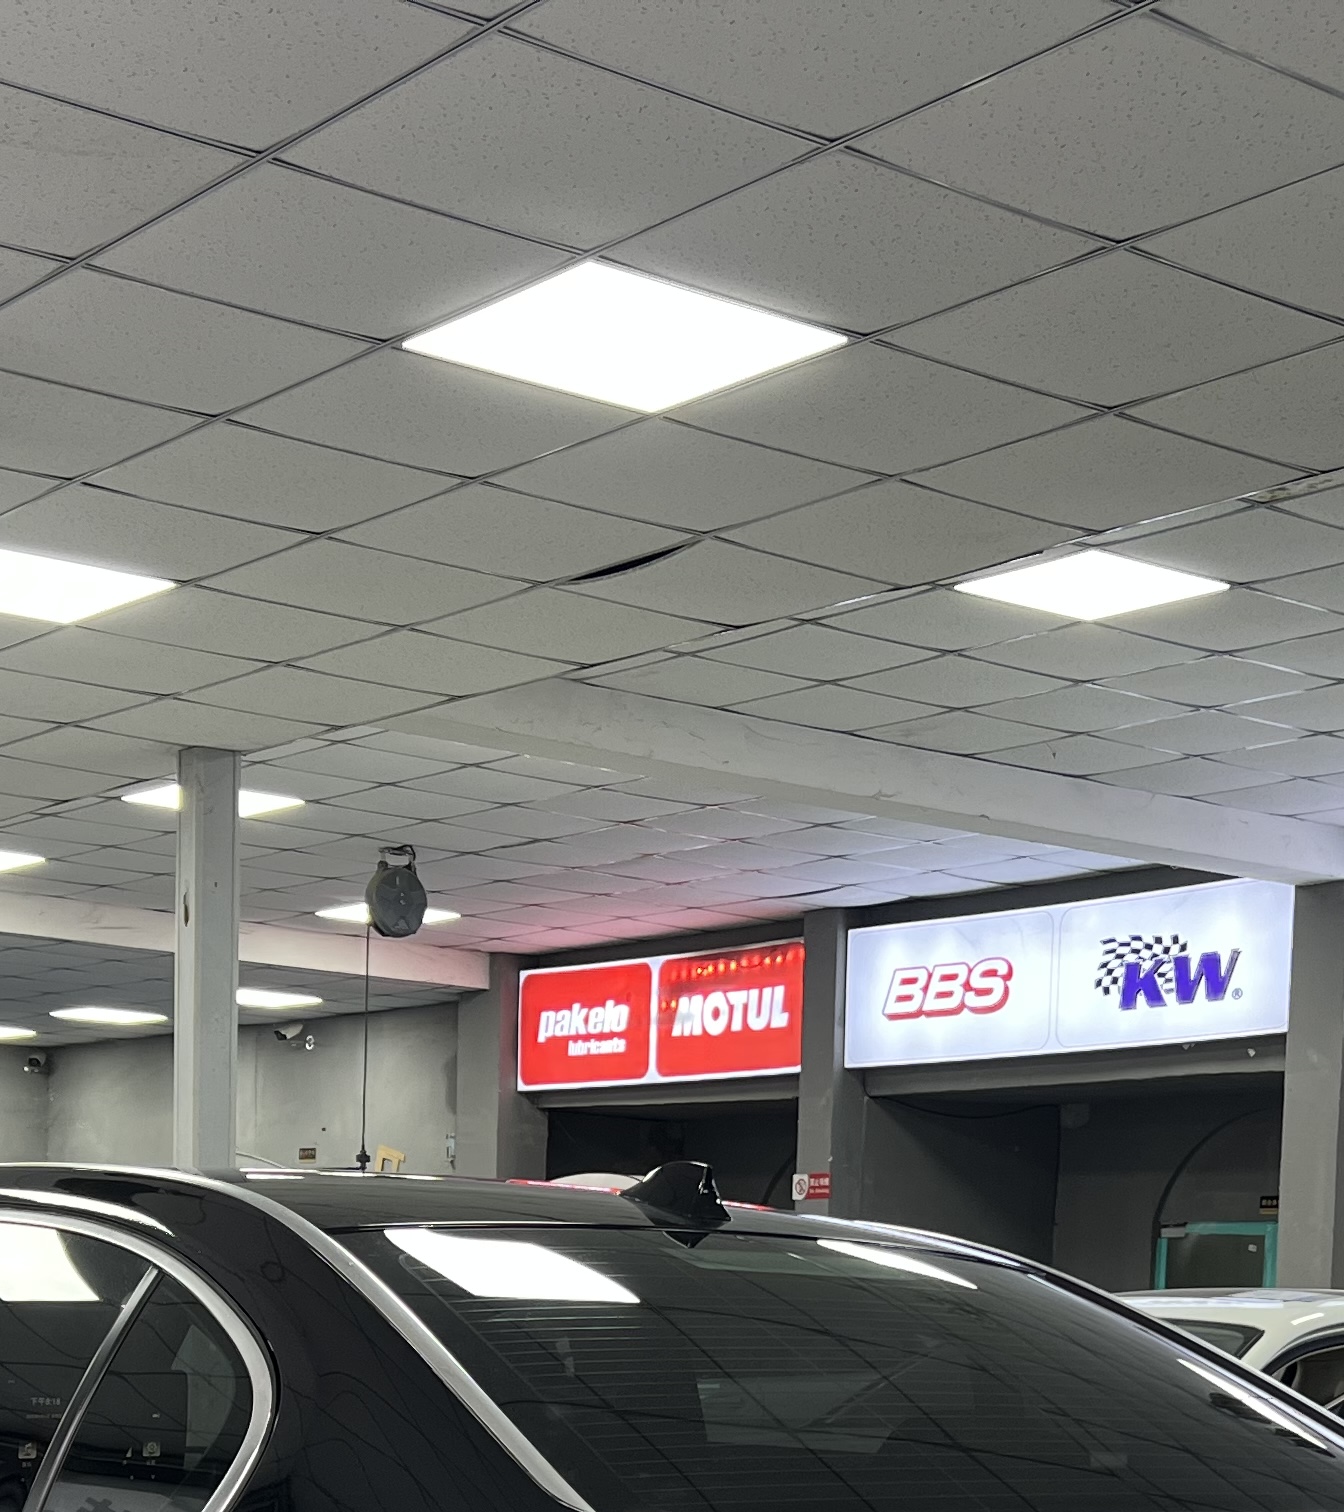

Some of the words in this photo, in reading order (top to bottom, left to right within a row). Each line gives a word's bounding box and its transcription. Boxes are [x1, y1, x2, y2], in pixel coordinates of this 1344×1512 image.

[882, 957, 1013, 1021] BBS
[1119, 949, 1242, 1011] KW
[537, 1000, 630, 1043] pakelo
[671, 985, 789, 1037] MOTUL
[567, 1037, 626, 1056] lubricants
